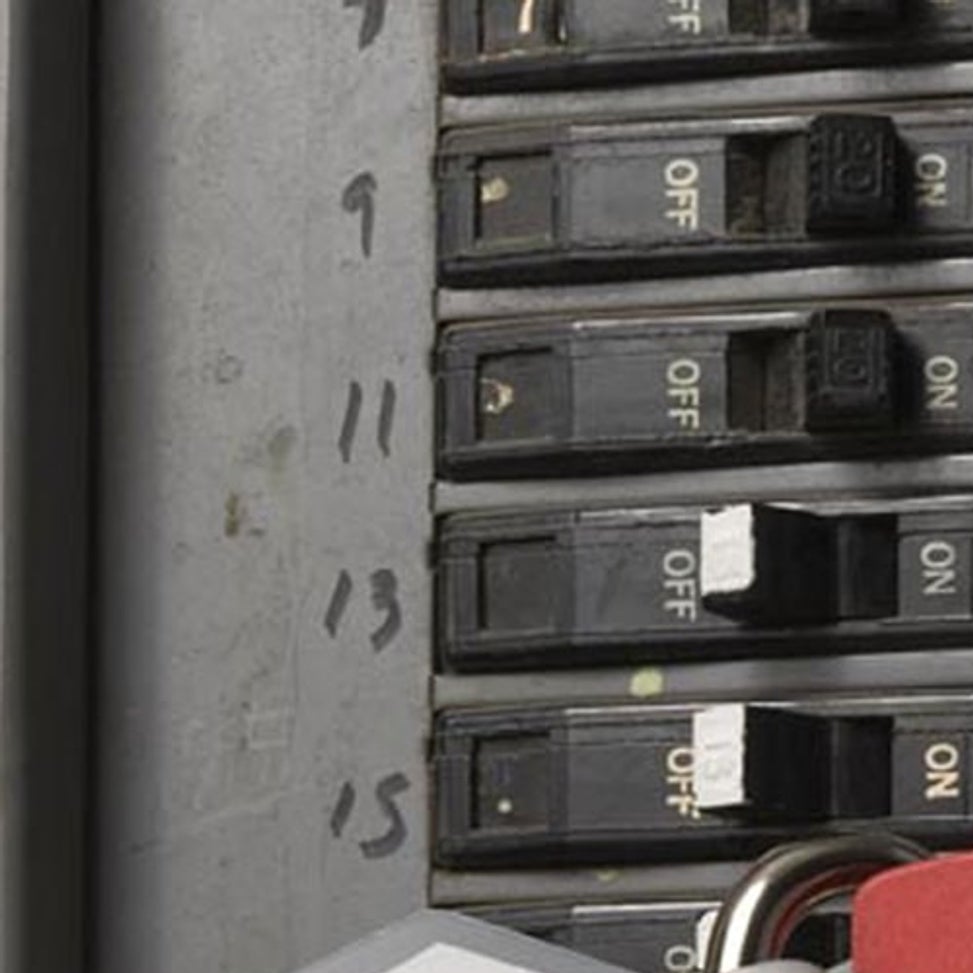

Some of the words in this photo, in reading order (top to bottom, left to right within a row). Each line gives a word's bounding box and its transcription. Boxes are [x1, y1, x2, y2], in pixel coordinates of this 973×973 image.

[668, 0, 701, 33] FF
[340, 171, 378, 258] 9
[665, 158, 699, 231] OFF
[917, 152, 948, 207] ON
[667, 358, 700, 429] OFF
[926, 354, 958, 409] ON
[338, 379, 396, 463] 11
[663, 549, 697, 621] OFF
[921, 541, 955, 595] ON
[324, 568, 402, 652] 13
[925, 743, 958, 799] ON
[330, 772, 410, 859] 15
